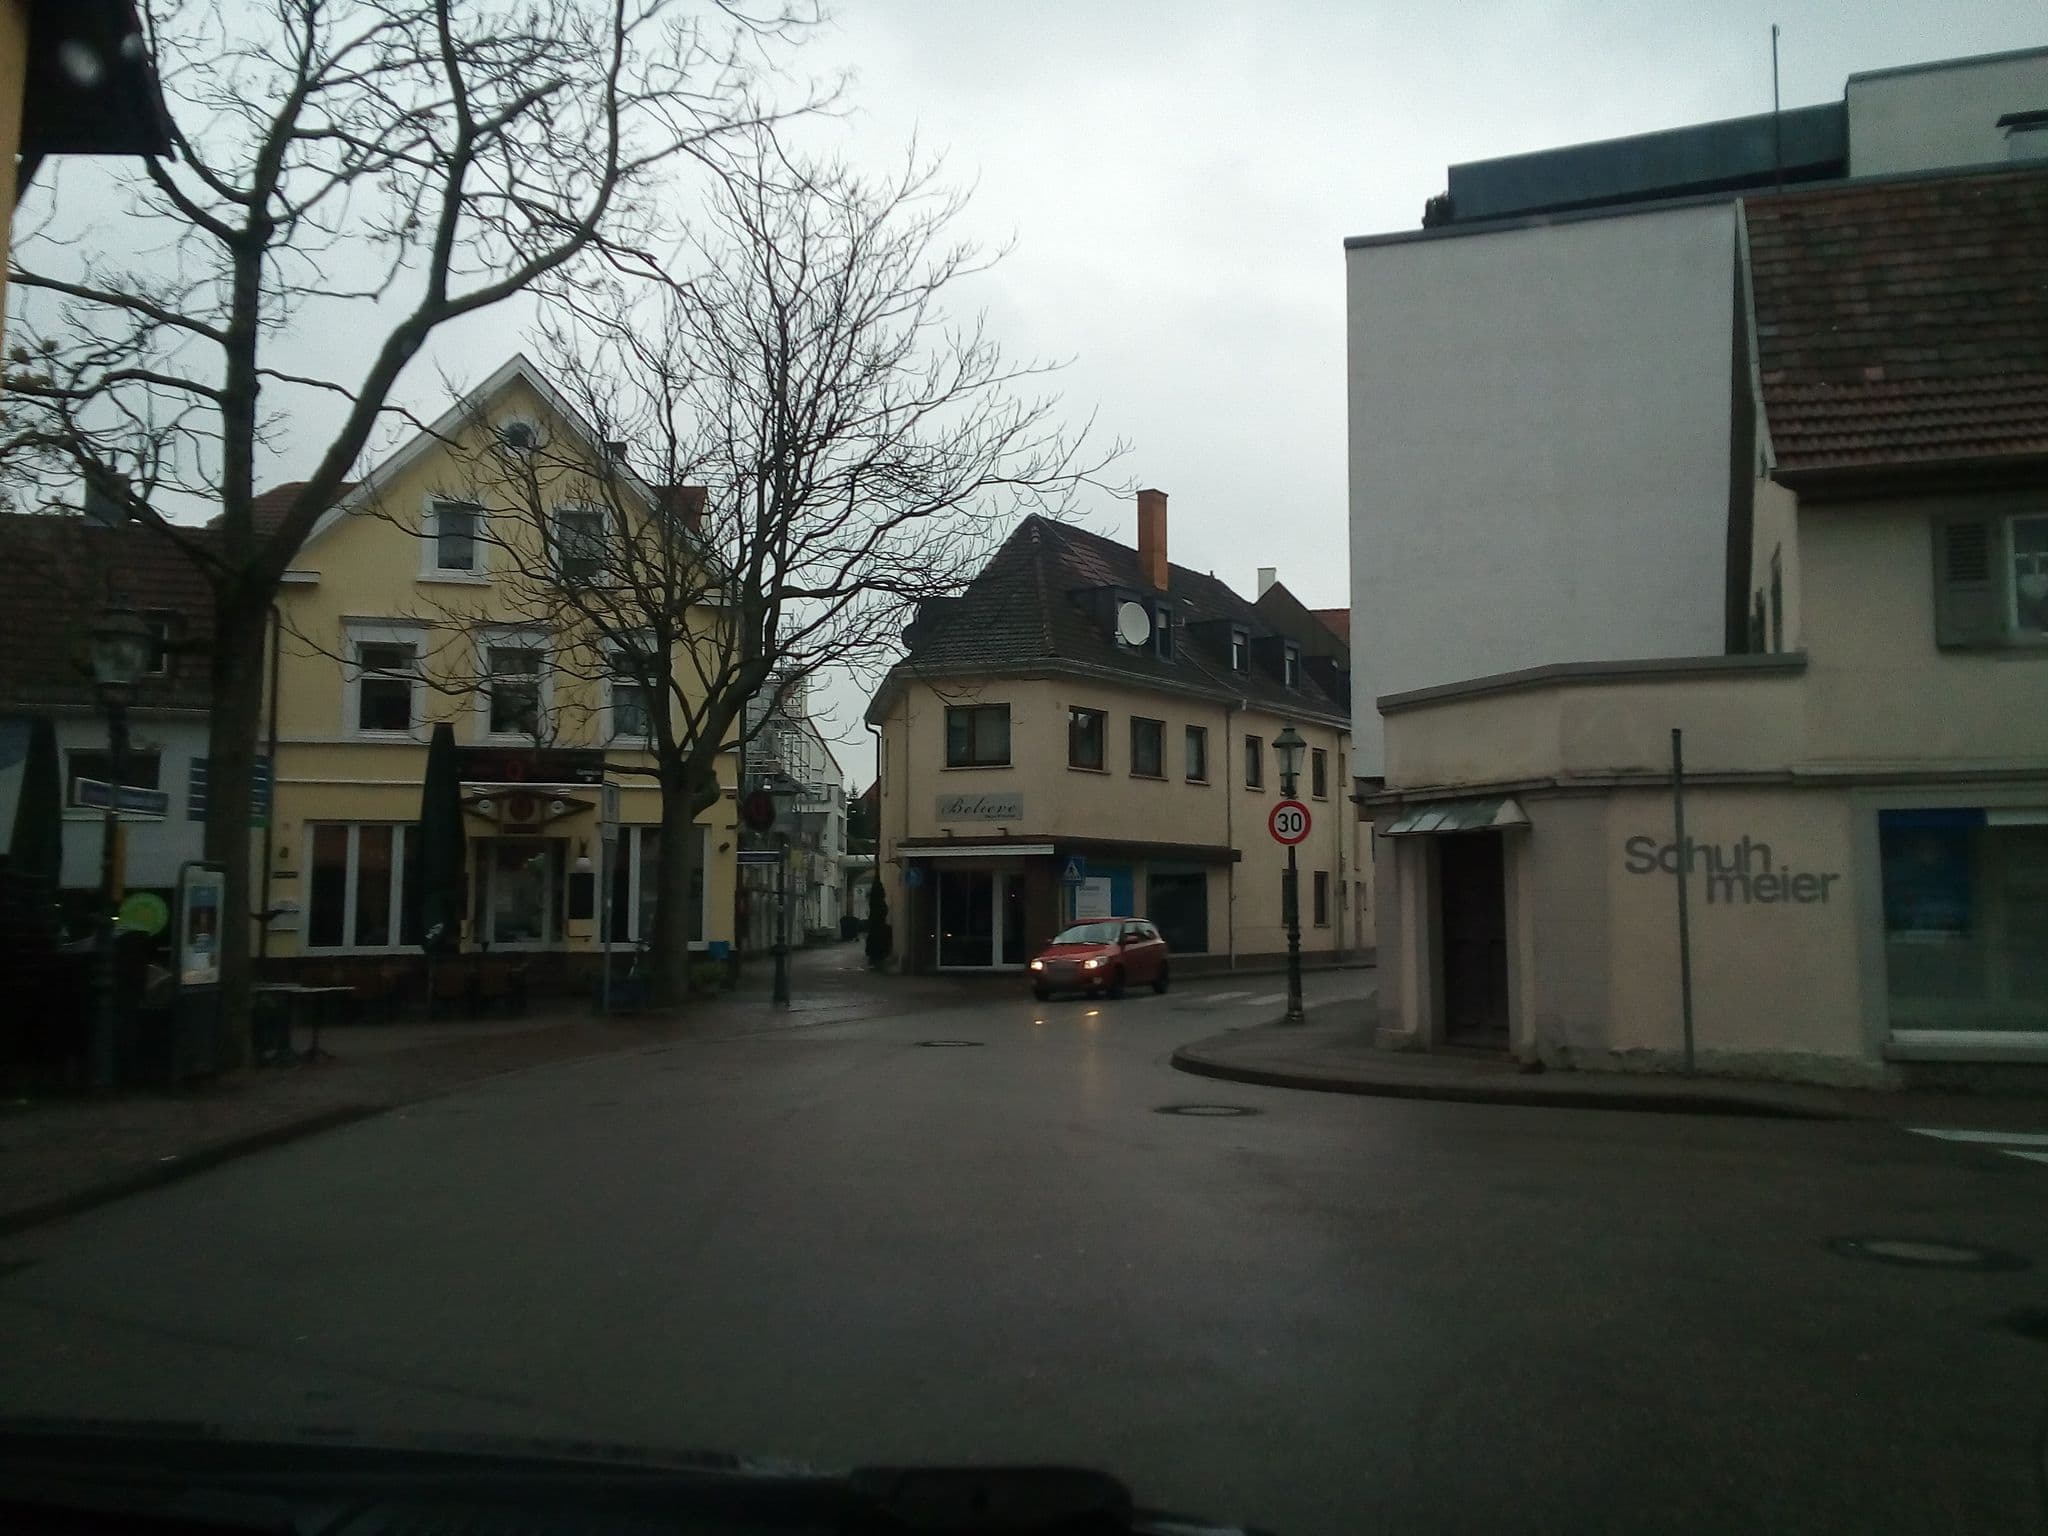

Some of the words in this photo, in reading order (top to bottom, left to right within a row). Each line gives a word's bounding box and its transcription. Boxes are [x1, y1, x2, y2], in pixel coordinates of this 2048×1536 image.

[1278, 813, 1302, 832] 30
[1624, 834, 1772, 874] Schuh
[1707, 865, 1840, 904] meier
